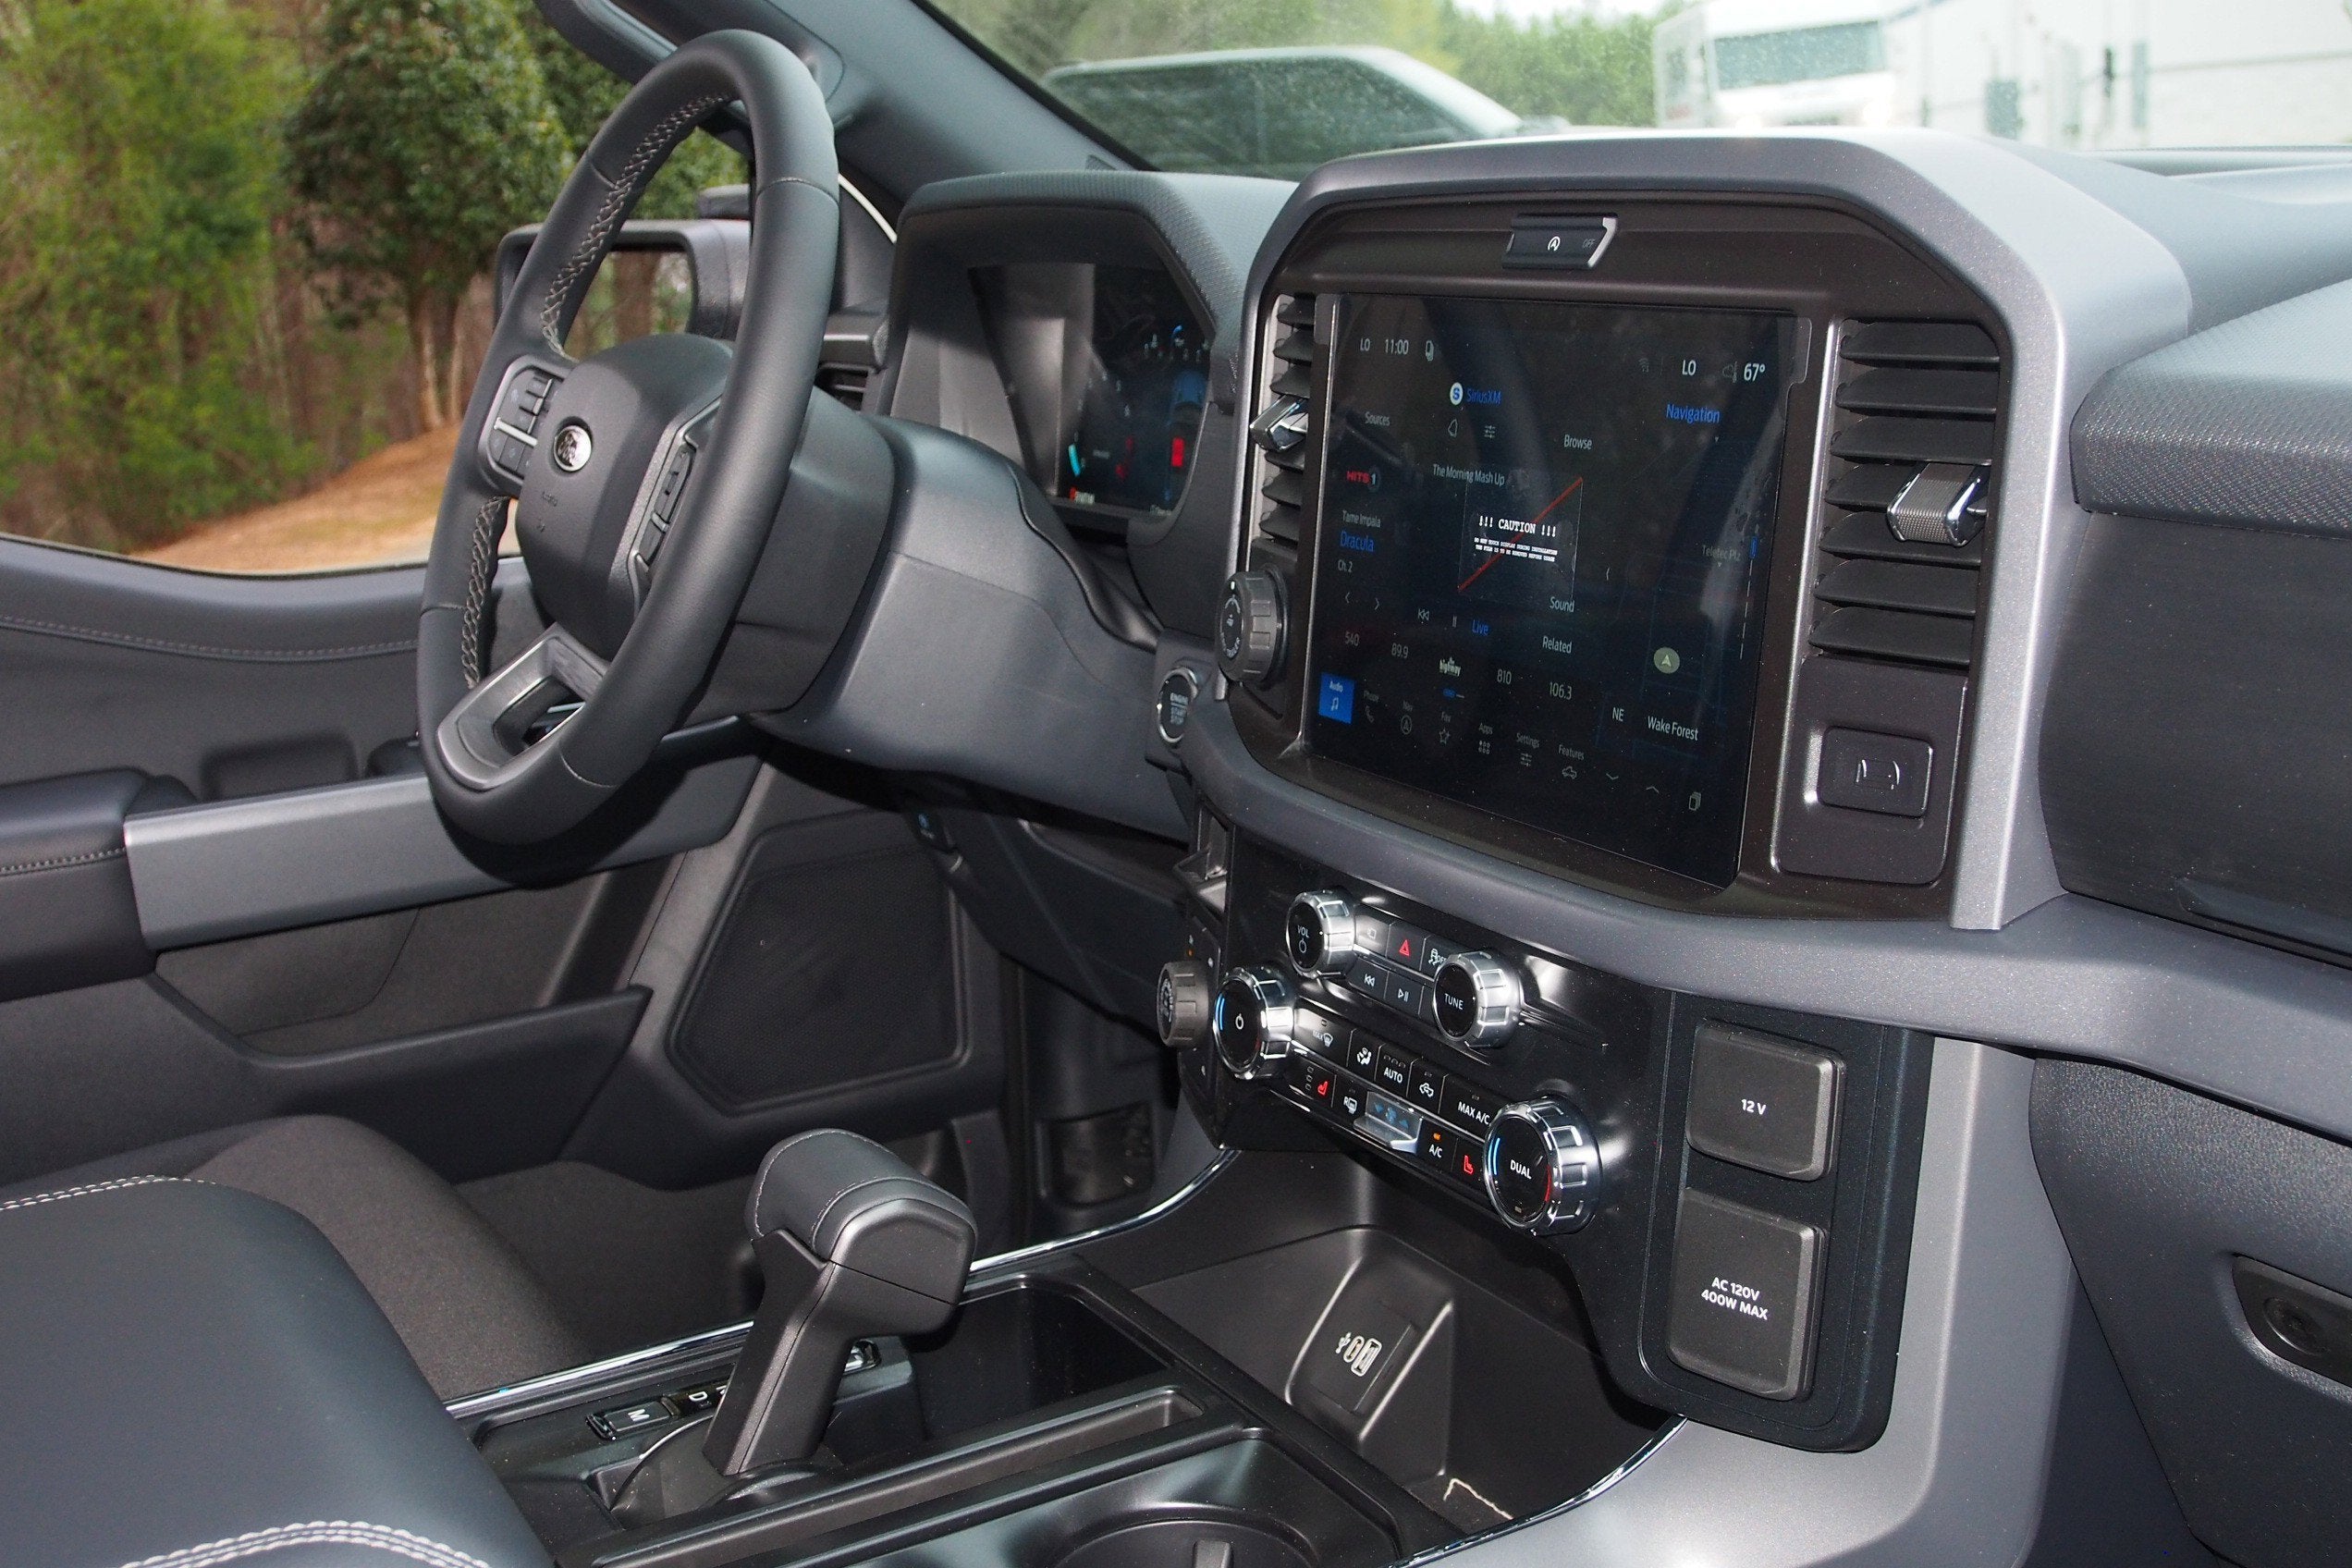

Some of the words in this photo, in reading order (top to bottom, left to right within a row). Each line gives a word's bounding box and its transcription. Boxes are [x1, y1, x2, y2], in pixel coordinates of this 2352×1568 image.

[1359, 337, 1371, 352] LO
[1385, 338, 1410, 356] 11:00
[1682, 359, 1697, 376] LO
[1743, 361, 1766, 382] 67°
[1466, 387, 1501, 407] SiriusXM
[1665, 403, 1721, 426] Navigation
[1563, 433, 1593, 451] Browse
[1433, 462, 1446, 477] The
[1446, 464, 1474, 484] Morning
[1474, 469, 1493, 485] Mash
[1494, 472, 1505, 488] Up
[1342, 509, 1360, 524] Tame
[1360, 512, 1381, 529] Impala
[1498, 518, 1537, 534] CAUTION
[1340, 530, 1375, 553] Dracula
[1549, 596, 1574, 613] Sound
[1472, 619, 1489, 636] Live
[1344, 631, 1360, 647] 540
[1542, 635, 1573, 655] Related
[1390, 643, 1409, 659] 89.9
[1496, 668, 1513, 685] 810
[1549, 681, 1573, 701] 106.3
[1611, 706, 1625, 722] NE
[1648, 715, 1671, 734] Wake
[1671, 721, 1699, 741] Forest
[1516, 731, 1541, 750] Settings
[1558, 743, 1586, 761] Features
[1297, 925, 1310, 938] VOL
[1443, 992, 1464, 1010] TUNE
[1383, 1067, 1403, 1084] AUTO
[1458, 1101, 1475, 1119] MAX
[1475, 1111, 1492, 1126] A/C
[1741, 1098, 1755, 1113] 12
[1756, 1102, 1767, 1116] V
[1428, 1144, 1443, 1159] A/C
[1509, 1158, 1532, 1180] DUAL
[1711, 1277, 1730, 1292] AC
[1730, 1281, 1760, 1302] 120V
[1700, 1289, 1738, 1312] 400W
[1738, 1301, 1770, 1321] MAX
